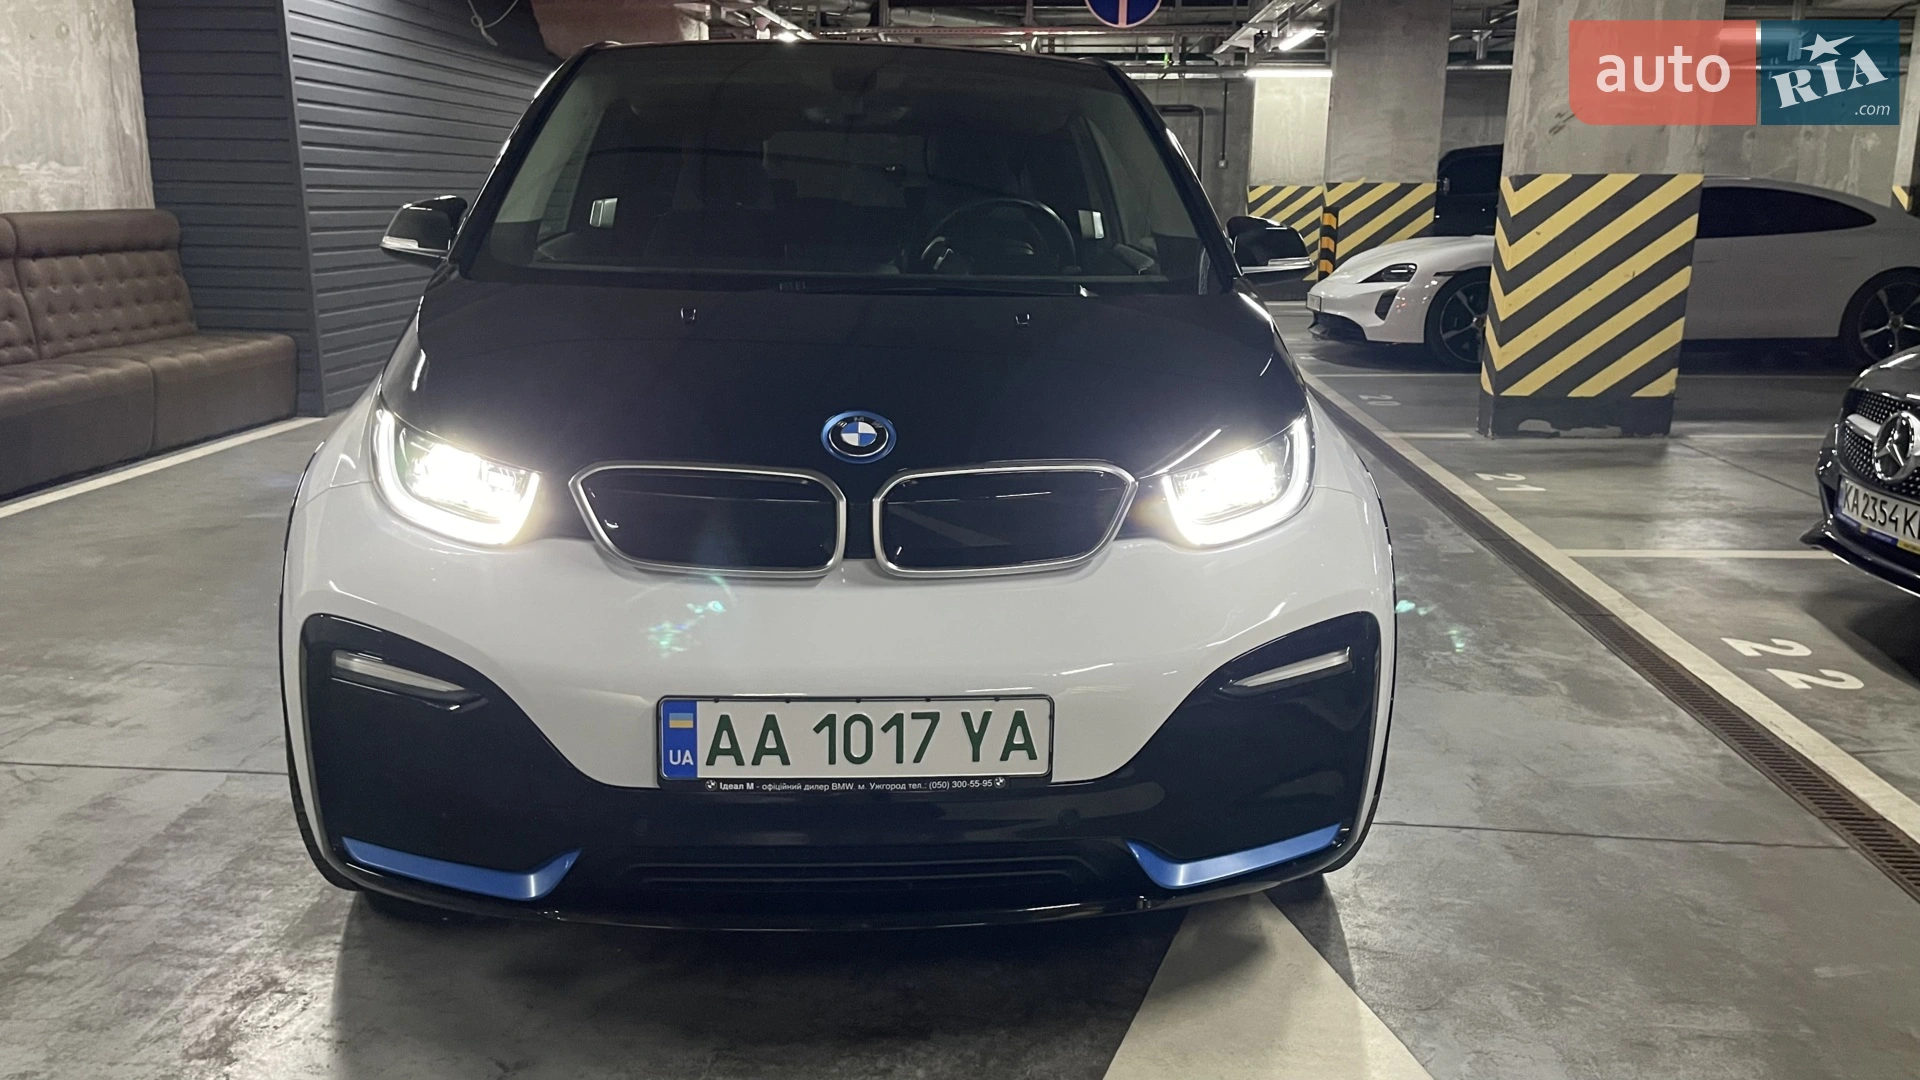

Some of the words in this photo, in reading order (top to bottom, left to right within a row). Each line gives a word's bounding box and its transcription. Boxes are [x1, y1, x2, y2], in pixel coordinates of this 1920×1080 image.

[1475, 472, 1546, 492] 21
[1843, 484, 1859, 516] KA
[1861, 492, 1899, 532] 2354
[1720, 637, 1865, 690] 22
[705, 714, 791, 767] AA
[813, 712, 940, 765] 1017
[961, 710, 1038, 763] YA
[669, 749, 694, 766] UA
[803, 782, 830, 792] дилер
[869, 782, 907, 791] Ужгород
[929, 780, 950, 790] (050)
[951, 779, 993, 788] 300-55-95
